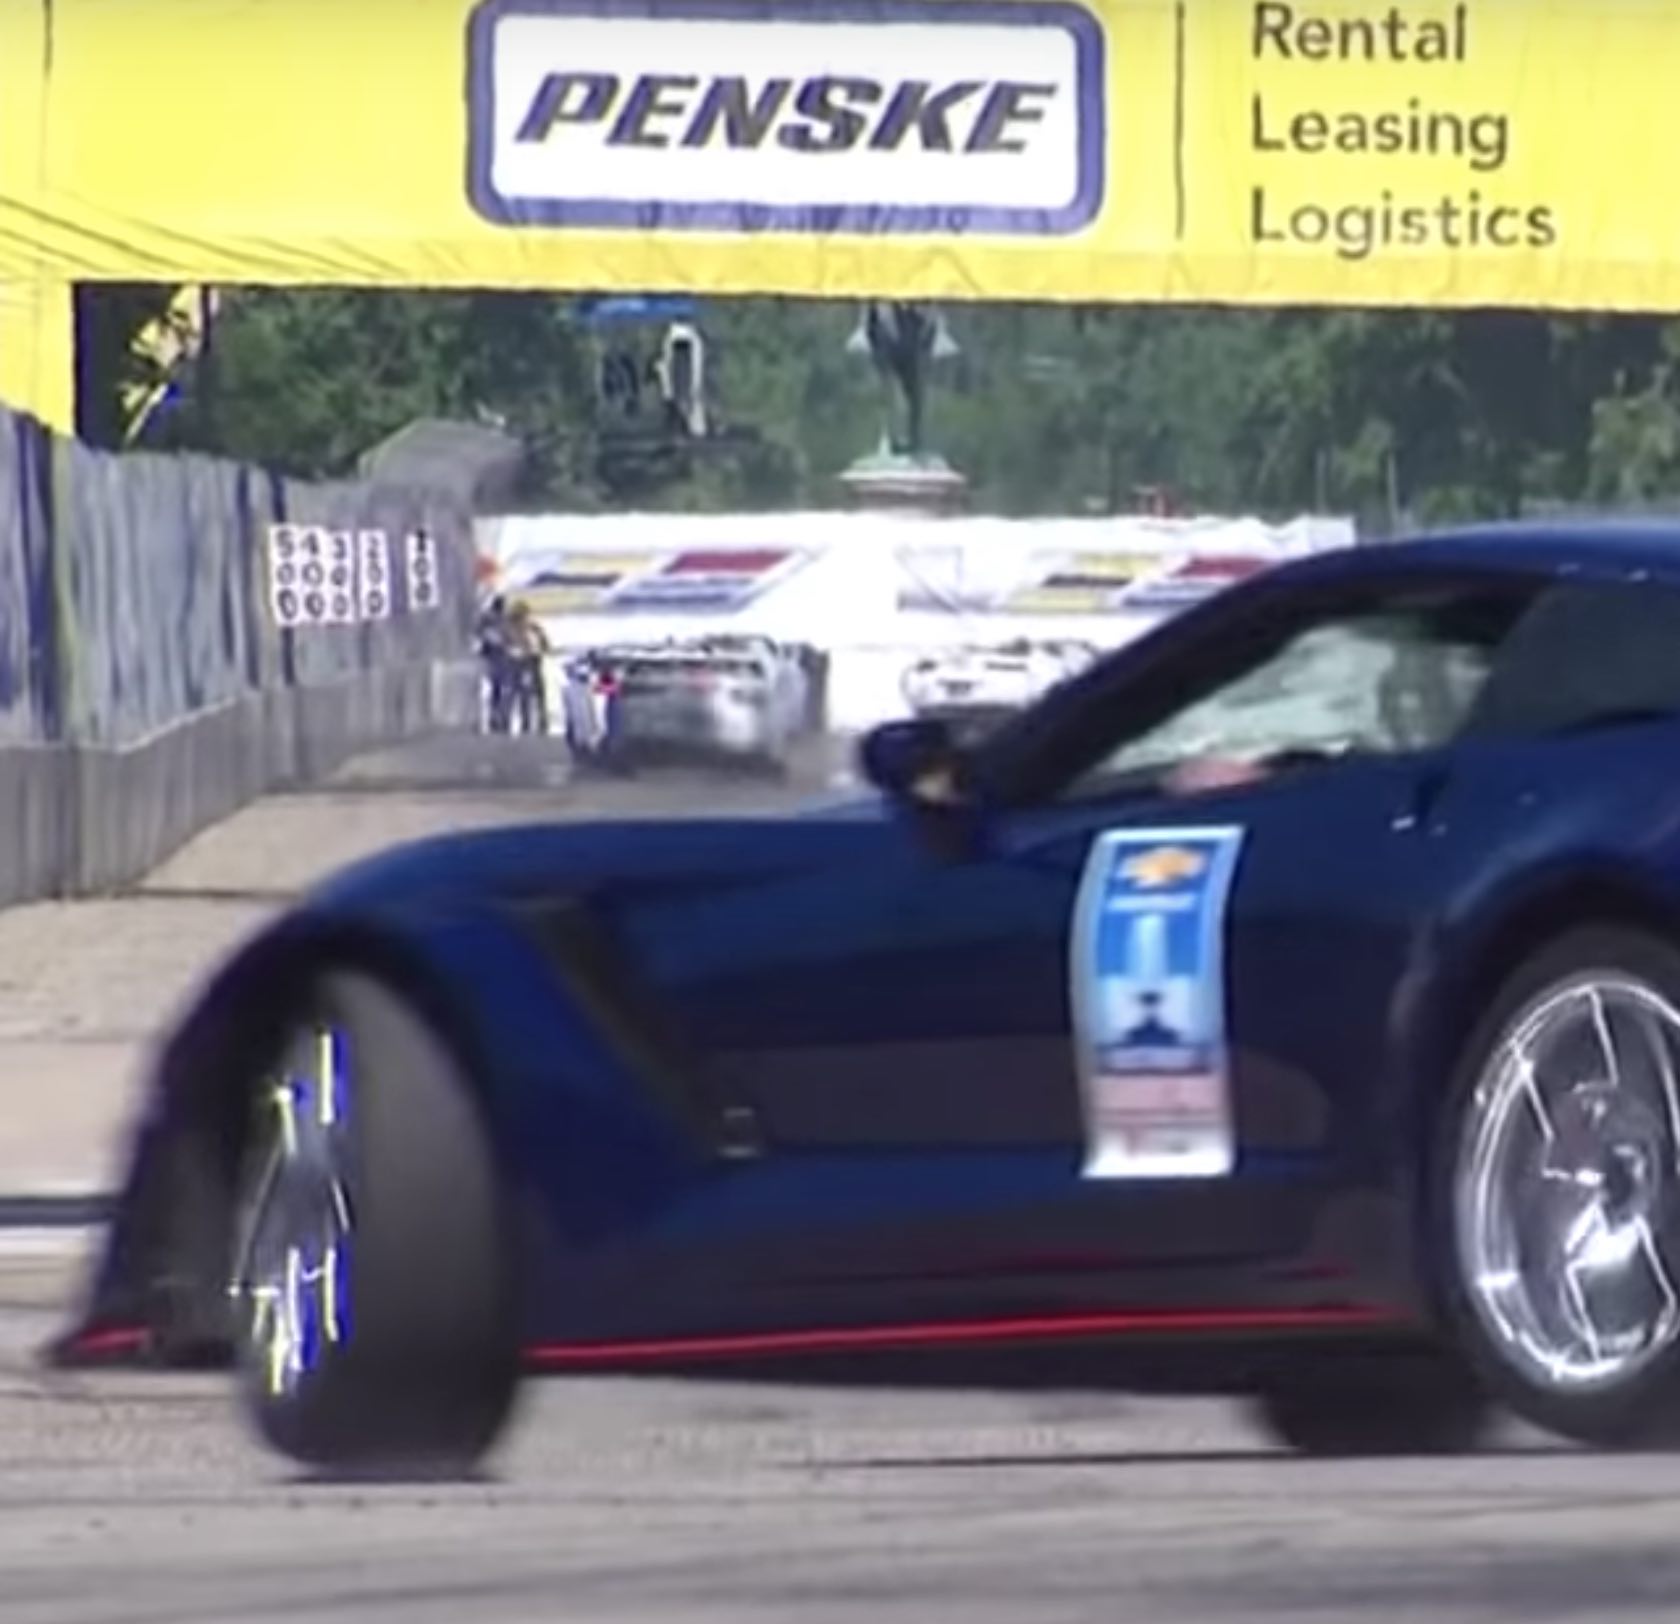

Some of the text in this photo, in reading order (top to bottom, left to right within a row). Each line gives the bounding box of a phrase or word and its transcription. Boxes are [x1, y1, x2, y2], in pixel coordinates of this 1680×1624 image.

[1252, 1, 1467, 62] Rental
[513, 71, 1059, 154] PENSKE
[1252, 92, 1509, 172] Leasing
[1252, 186, 1556, 260] Logistics
